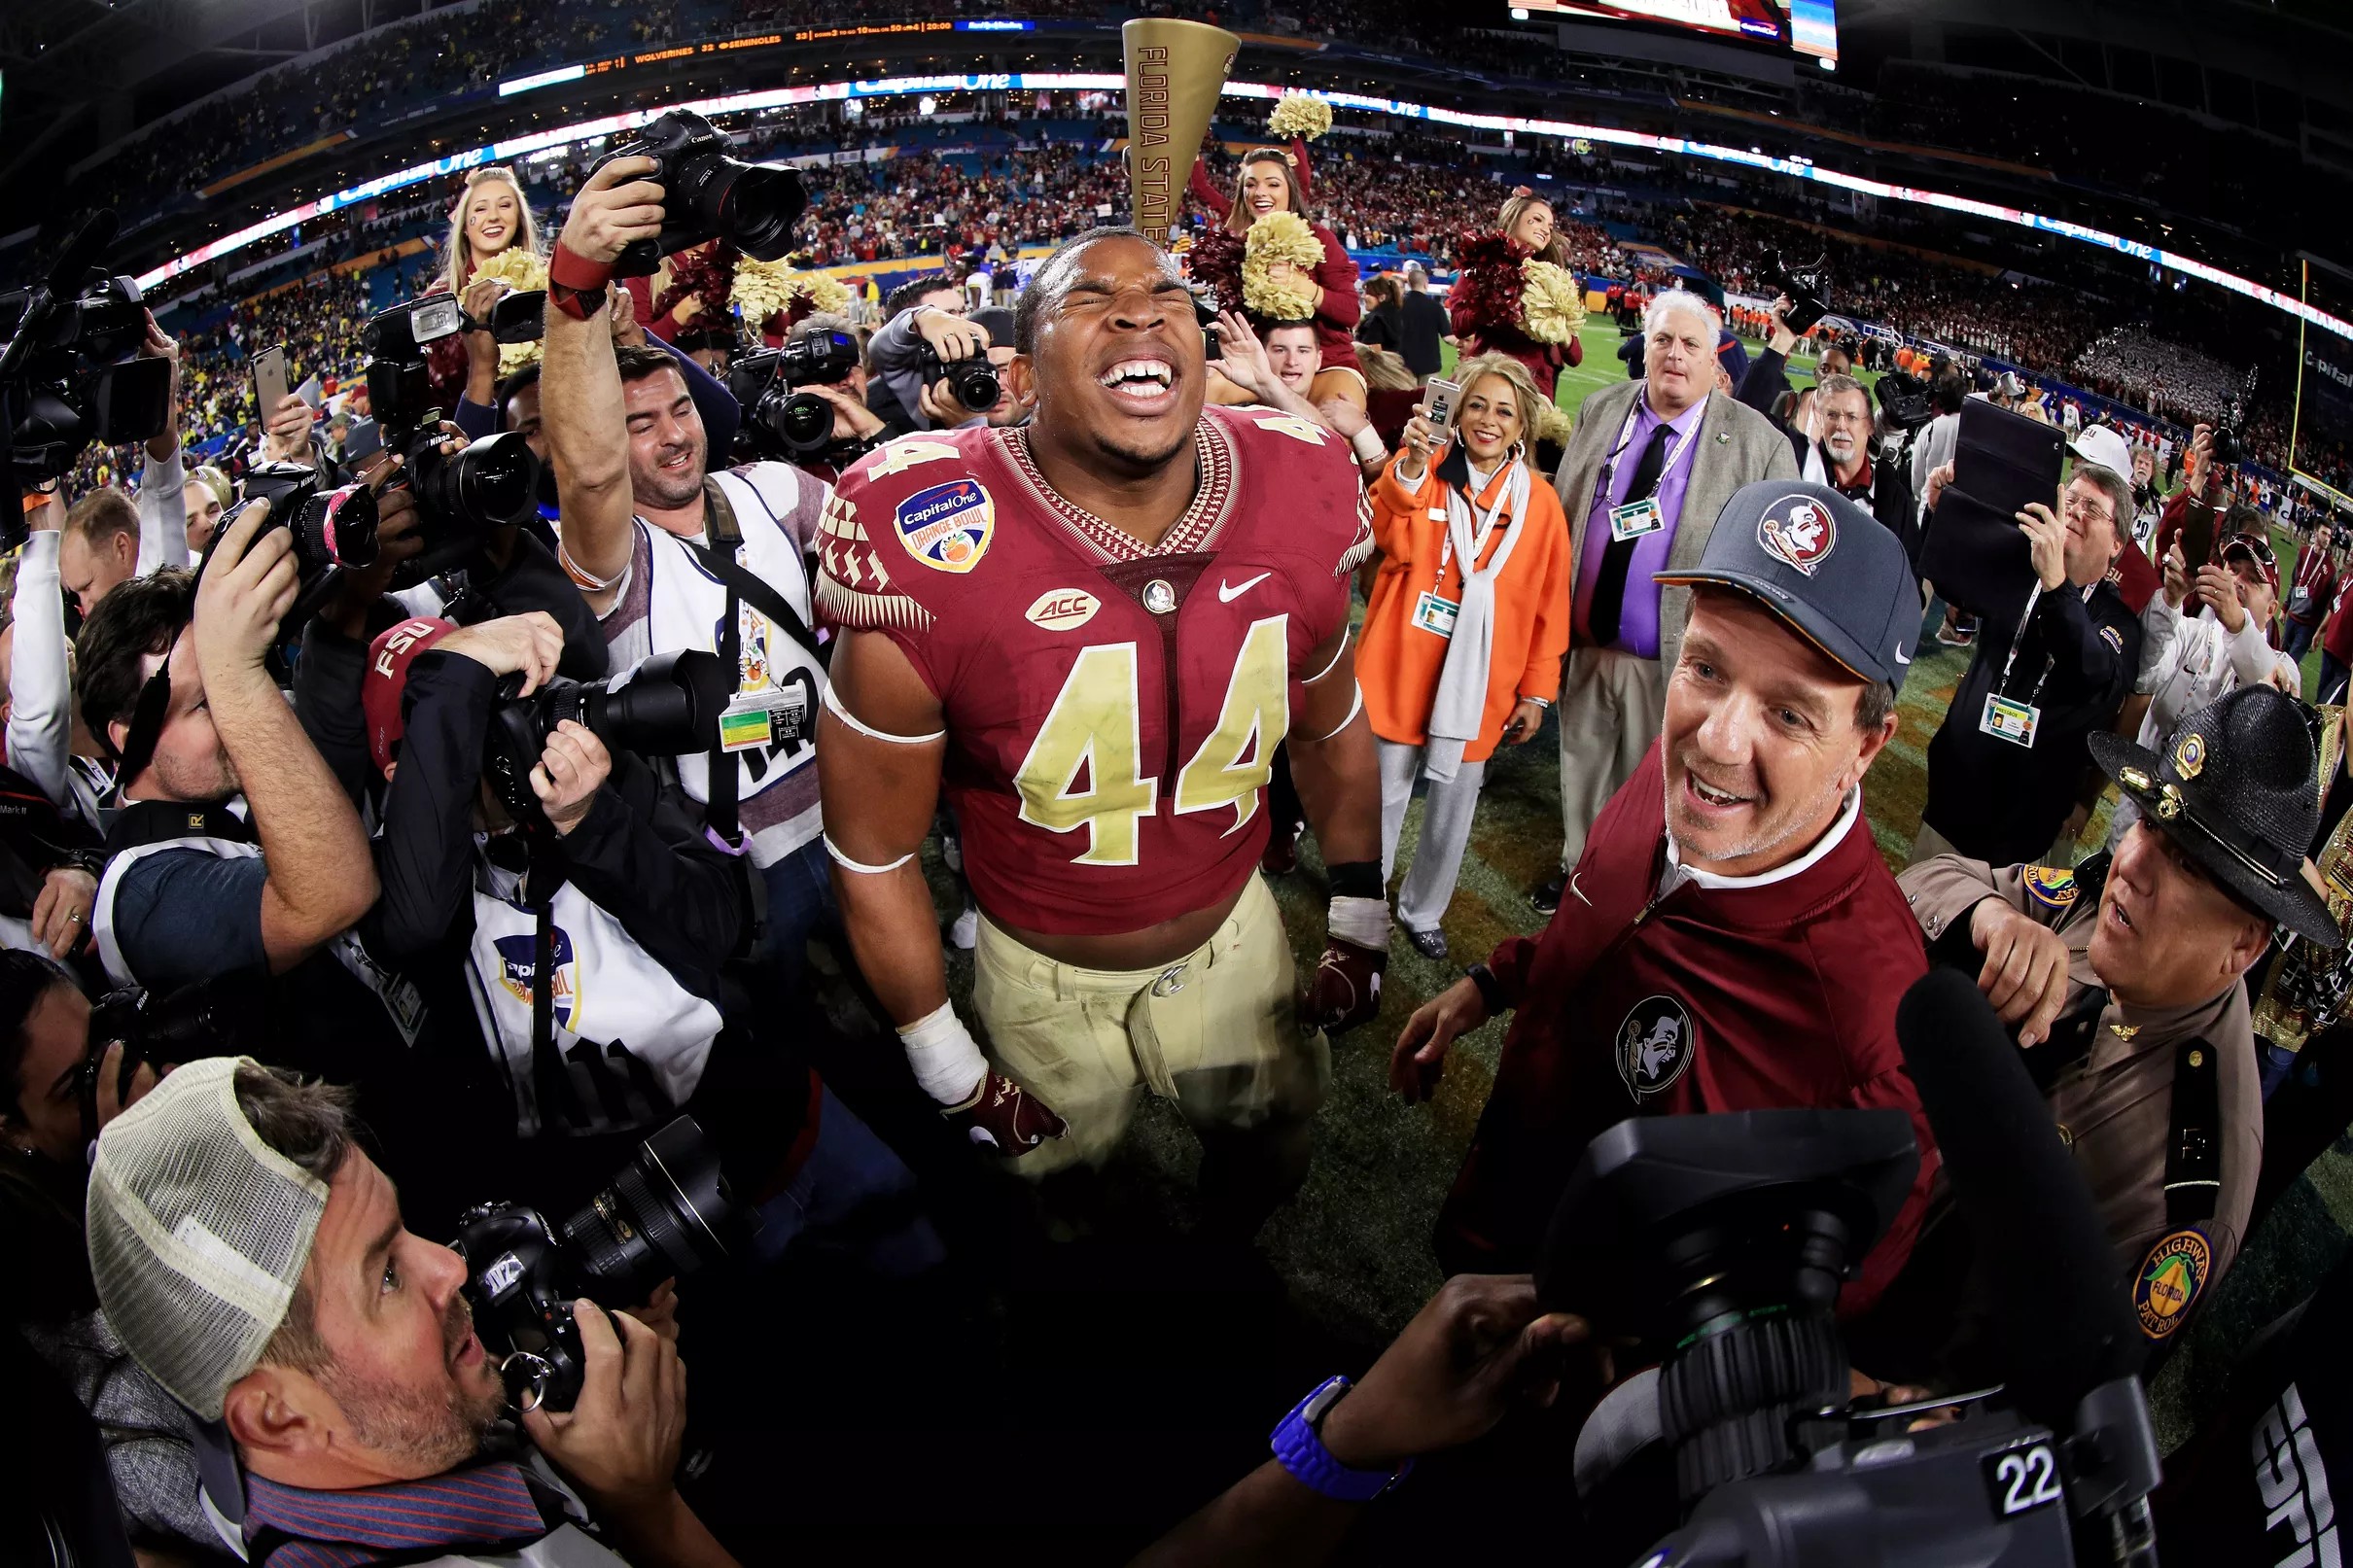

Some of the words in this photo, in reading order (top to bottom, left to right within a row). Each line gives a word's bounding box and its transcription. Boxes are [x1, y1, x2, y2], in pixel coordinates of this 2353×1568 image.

[634, 47, 694, 64] WOLVERINES
[701, 43, 715, 52] 32
[728, 35, 782, 49] SEMINOLES
[795, 32, 808, 41] 33
[1138, 47, 1170, 148] FLORIDA
[691, 133, 714, 144] Canon
[1141, 156, 1171, 242] STATE
[2303, 351, 2353, 388] Cpital
[430, 433, 451, 447] Nikon
[300, 470, 318, 488] Nikon
[903, 492, 977, 525] CapitalOne
[911, 522, 954, 550] ORANGE
[954, 507, 988, 529] BOWL
[1037, 596, 1089, 618] ACC
[374, 621, 436, 680] FSU
[1012, 612, 1290, 865] 44
[0, 805, 19, 815] Mark
[2152, 1237, 2206, 1283] HIGHWAY
[2152, 1280, 2184, 1303] FLORIDA
[2138, 1300, 2178, 1332] PATROL
[1996, 1446, 2062, 1515] 22
